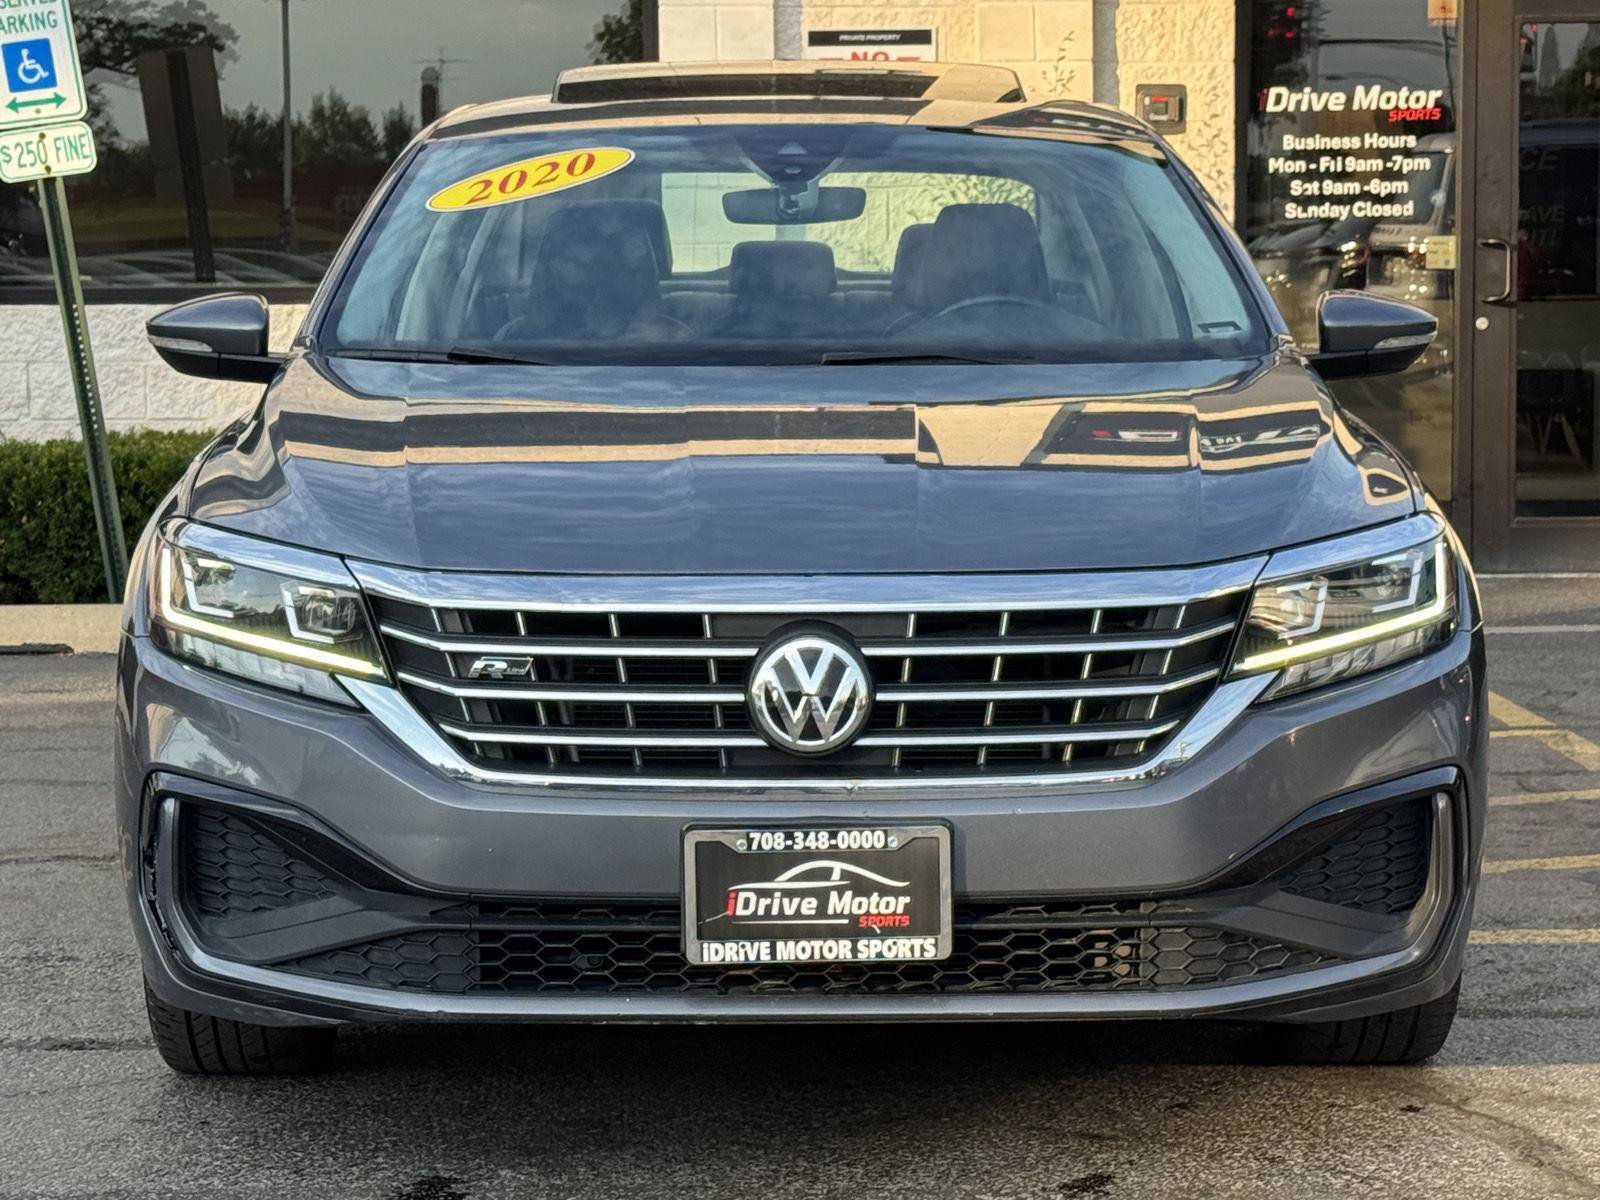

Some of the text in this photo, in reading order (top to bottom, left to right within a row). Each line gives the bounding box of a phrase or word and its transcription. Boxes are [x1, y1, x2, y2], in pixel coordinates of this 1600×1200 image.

[1259, 85, 1443, 113] iDrive Motor
[1388, 108, 1442, 122] SPORTS
[54, 133, 92, 163] FINE
[1282, 133, 1417, 151] Business Hours
[1268, 157, 1307, 174] Mon
[464, 152, 597, 206] 2020
[1352, 200, 1415, 218] Closed
[749, 829, 886, 851] 708-348-0000
[726, 888, 911, 917] iDrive Motor
[858, 914, 910, 928] SPORTS
[776, 940, 853, 961] MOTOR
[857, 937, 938, 960] SPORTS
